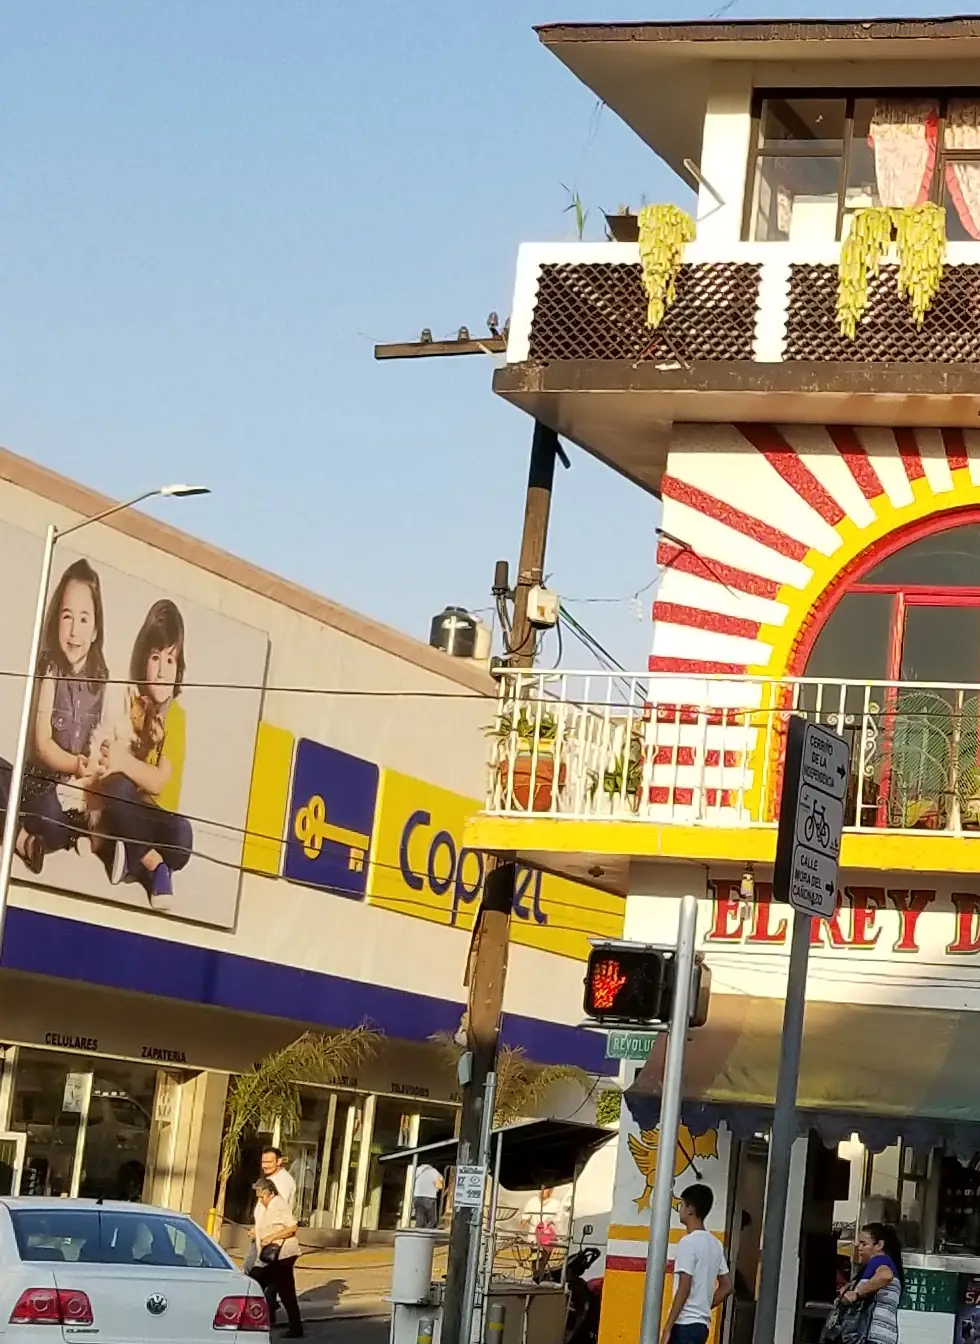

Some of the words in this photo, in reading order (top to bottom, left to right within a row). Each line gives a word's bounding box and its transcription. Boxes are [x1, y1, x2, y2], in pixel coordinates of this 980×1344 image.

[400, 809, 548, 925] Copel
[800, 854, 818, 872] CALLE
[811, 875, 822, 890] DEL
[706, 879, 788, 945] EL
[45, 1032, 98, 1051] CELULARES
